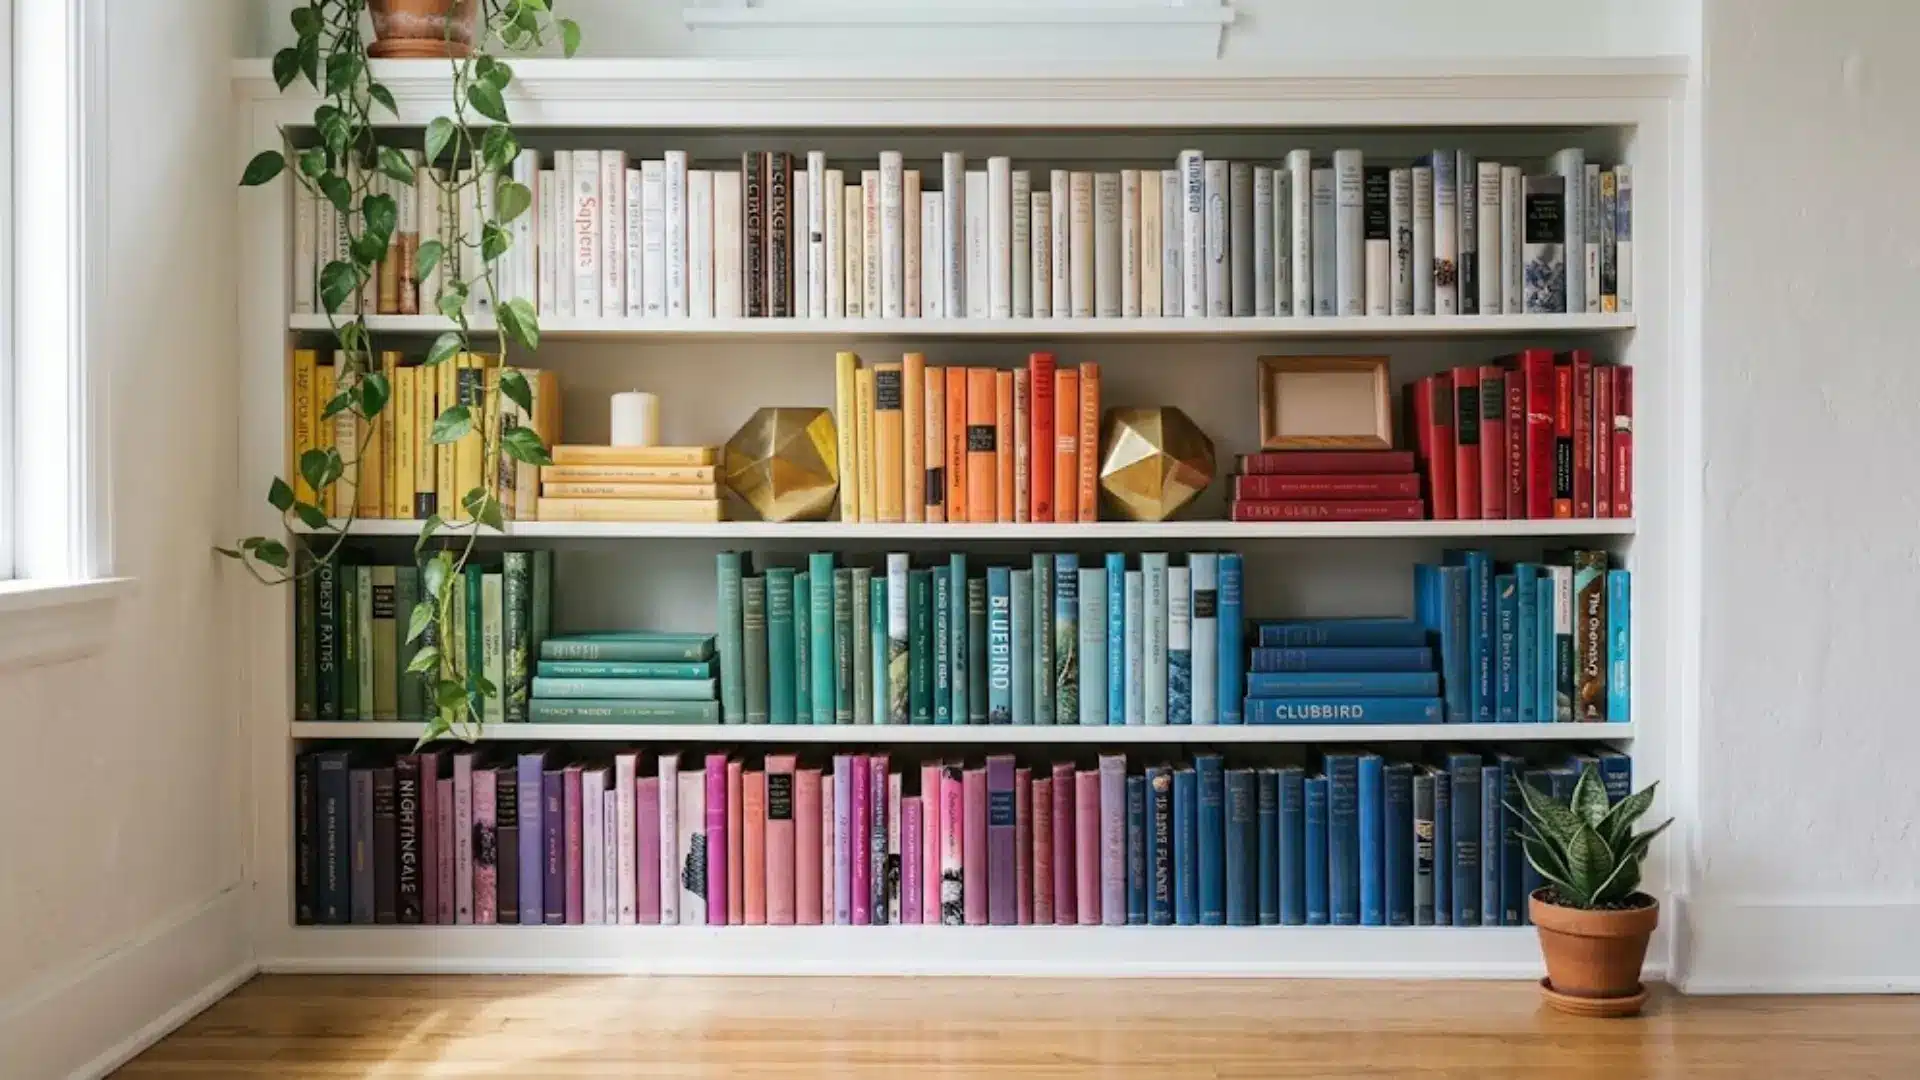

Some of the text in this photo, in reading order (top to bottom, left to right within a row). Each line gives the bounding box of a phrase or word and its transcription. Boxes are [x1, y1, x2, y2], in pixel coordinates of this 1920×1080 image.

[991, 596, 1009, 689] BLUEBIRD
[1276, 704, 1364, 719] CLUBBIRD
[399, 780, 416, 893] NIGHTINGALE
